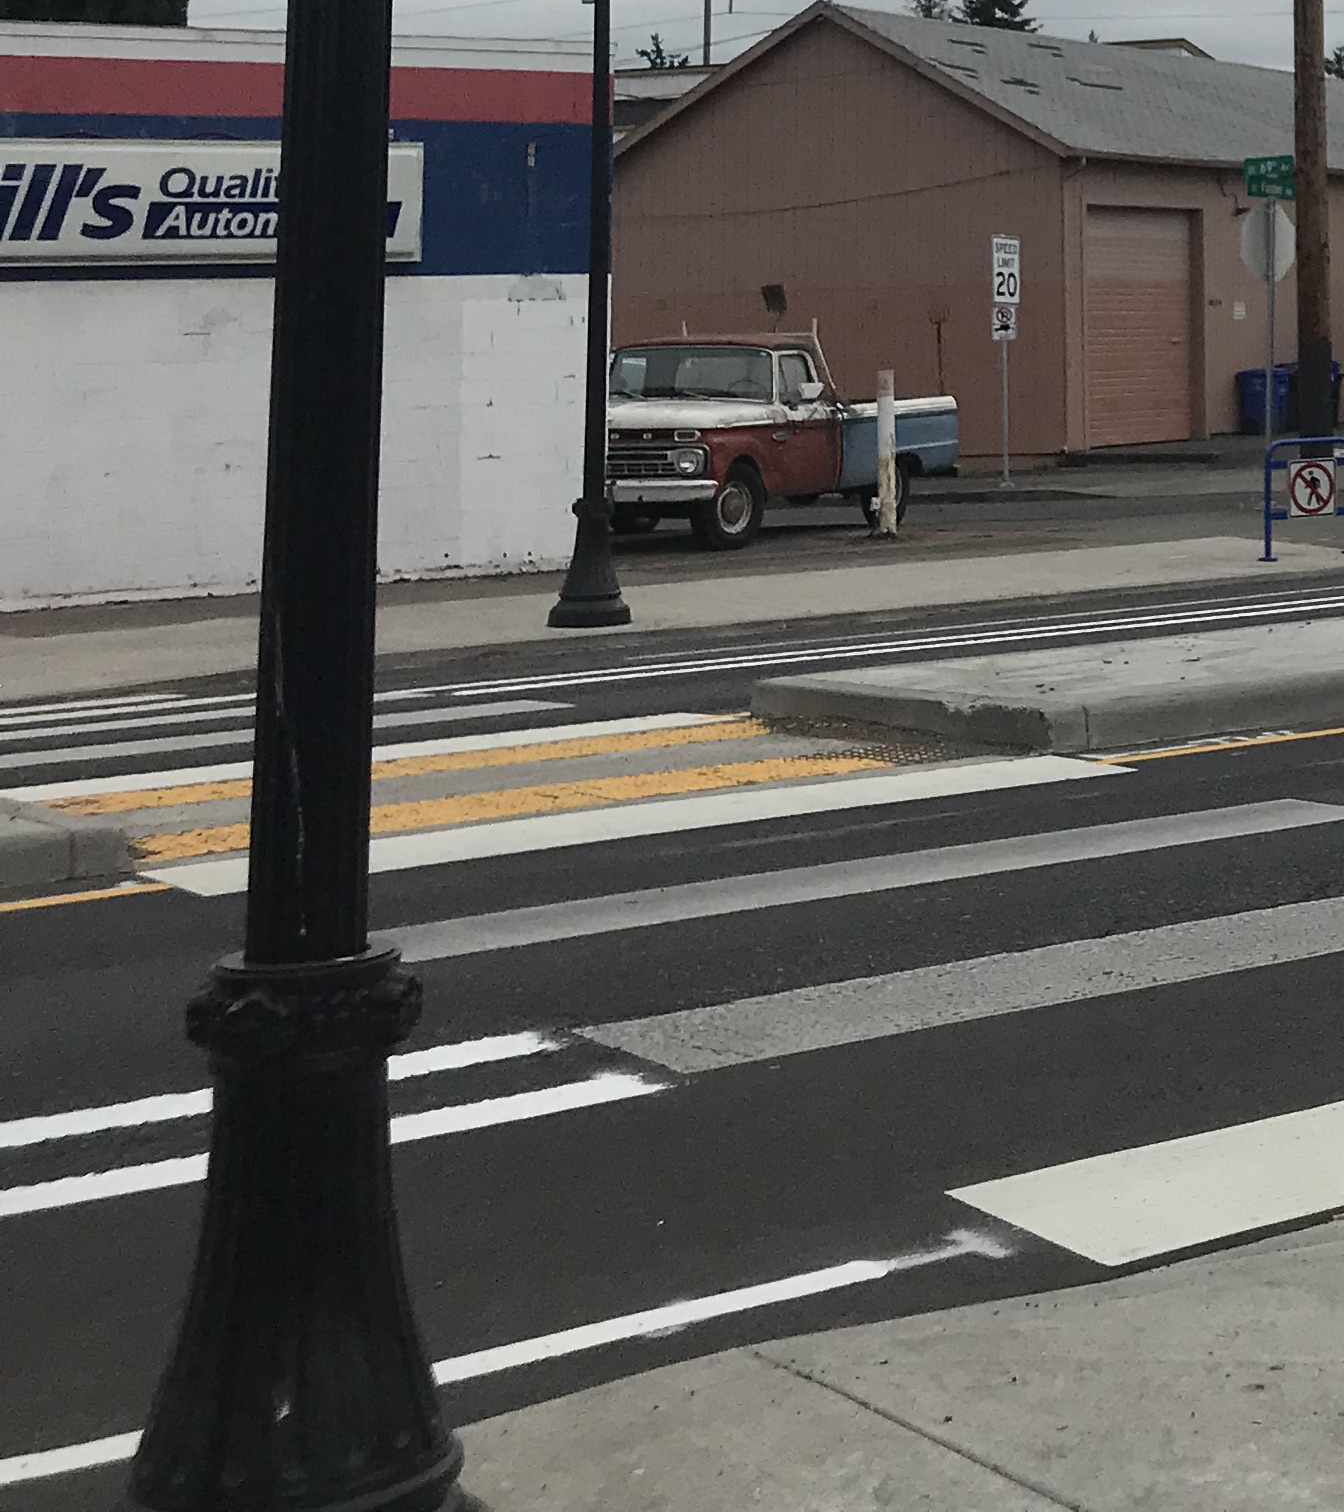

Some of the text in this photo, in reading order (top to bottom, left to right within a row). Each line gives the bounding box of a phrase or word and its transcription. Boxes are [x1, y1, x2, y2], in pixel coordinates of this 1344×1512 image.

[995, 242, 1018, 255] SPEED
[997, 257, 1016, 268] LIMIT
[996, 271, 1018, 298] 20
